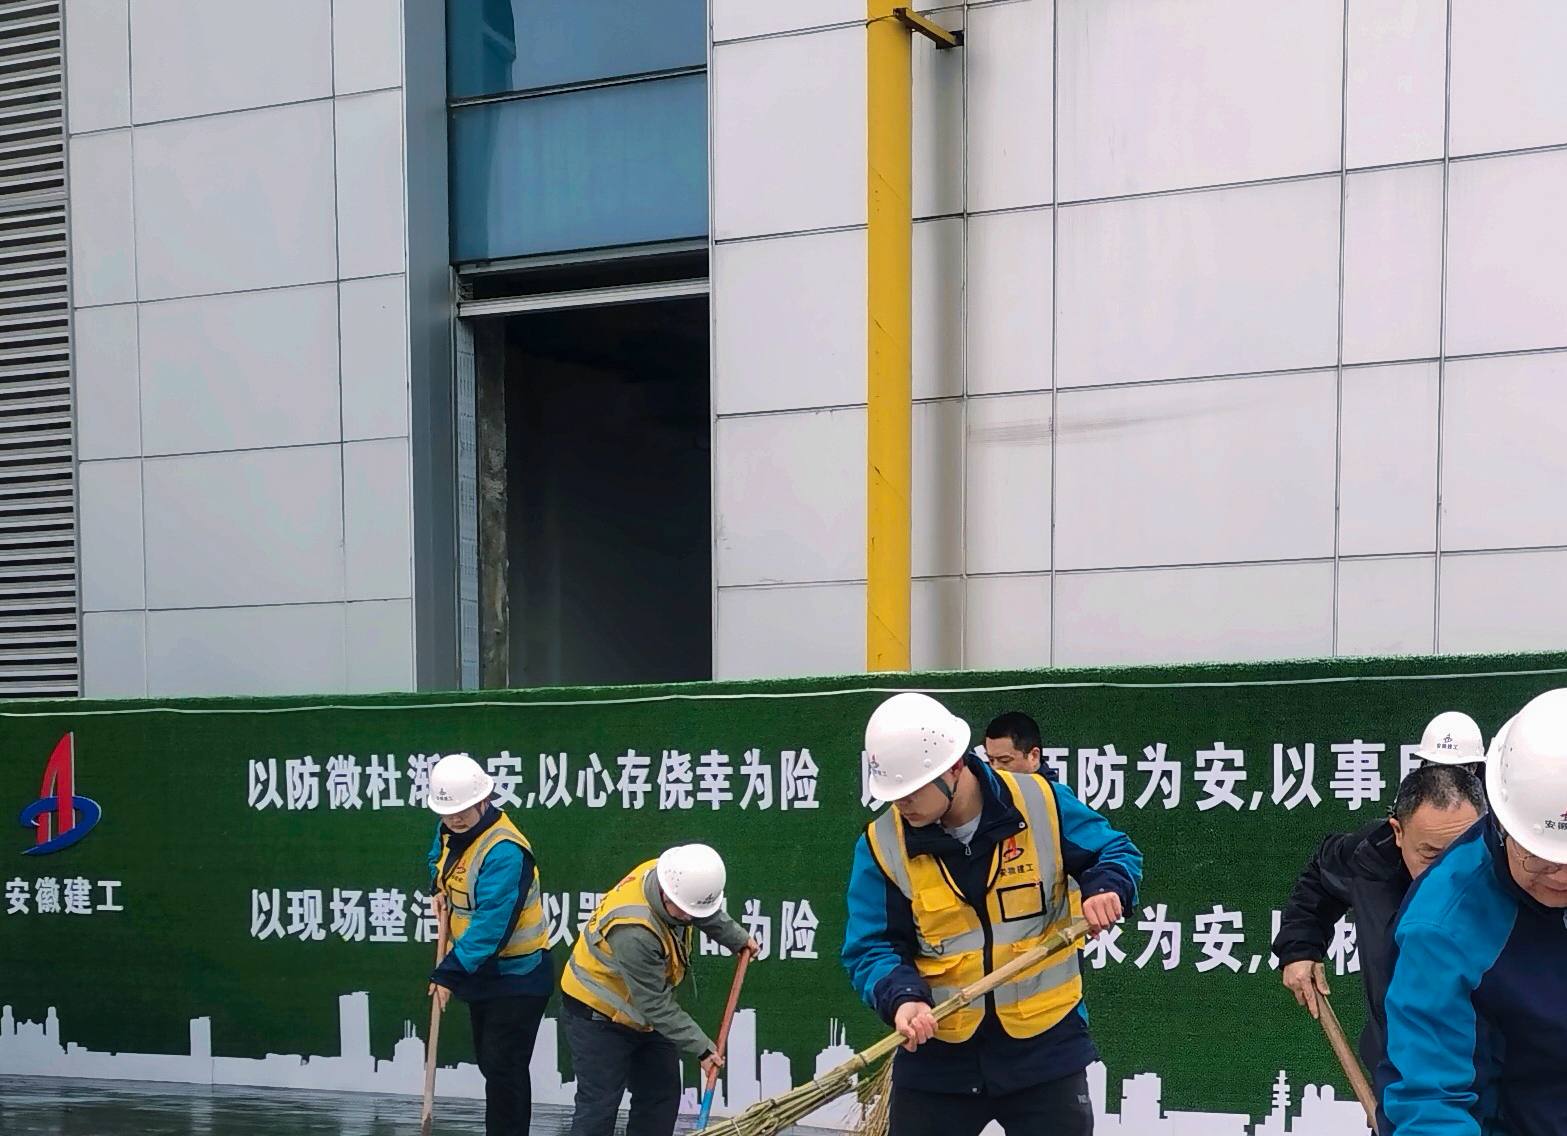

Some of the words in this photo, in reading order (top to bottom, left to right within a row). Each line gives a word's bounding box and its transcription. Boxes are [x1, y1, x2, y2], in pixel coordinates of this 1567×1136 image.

[248, 749, 819, 812] 以防微杜渐安,以心存侥幸为险
[4, 877, 124, 915] 安徽建工
